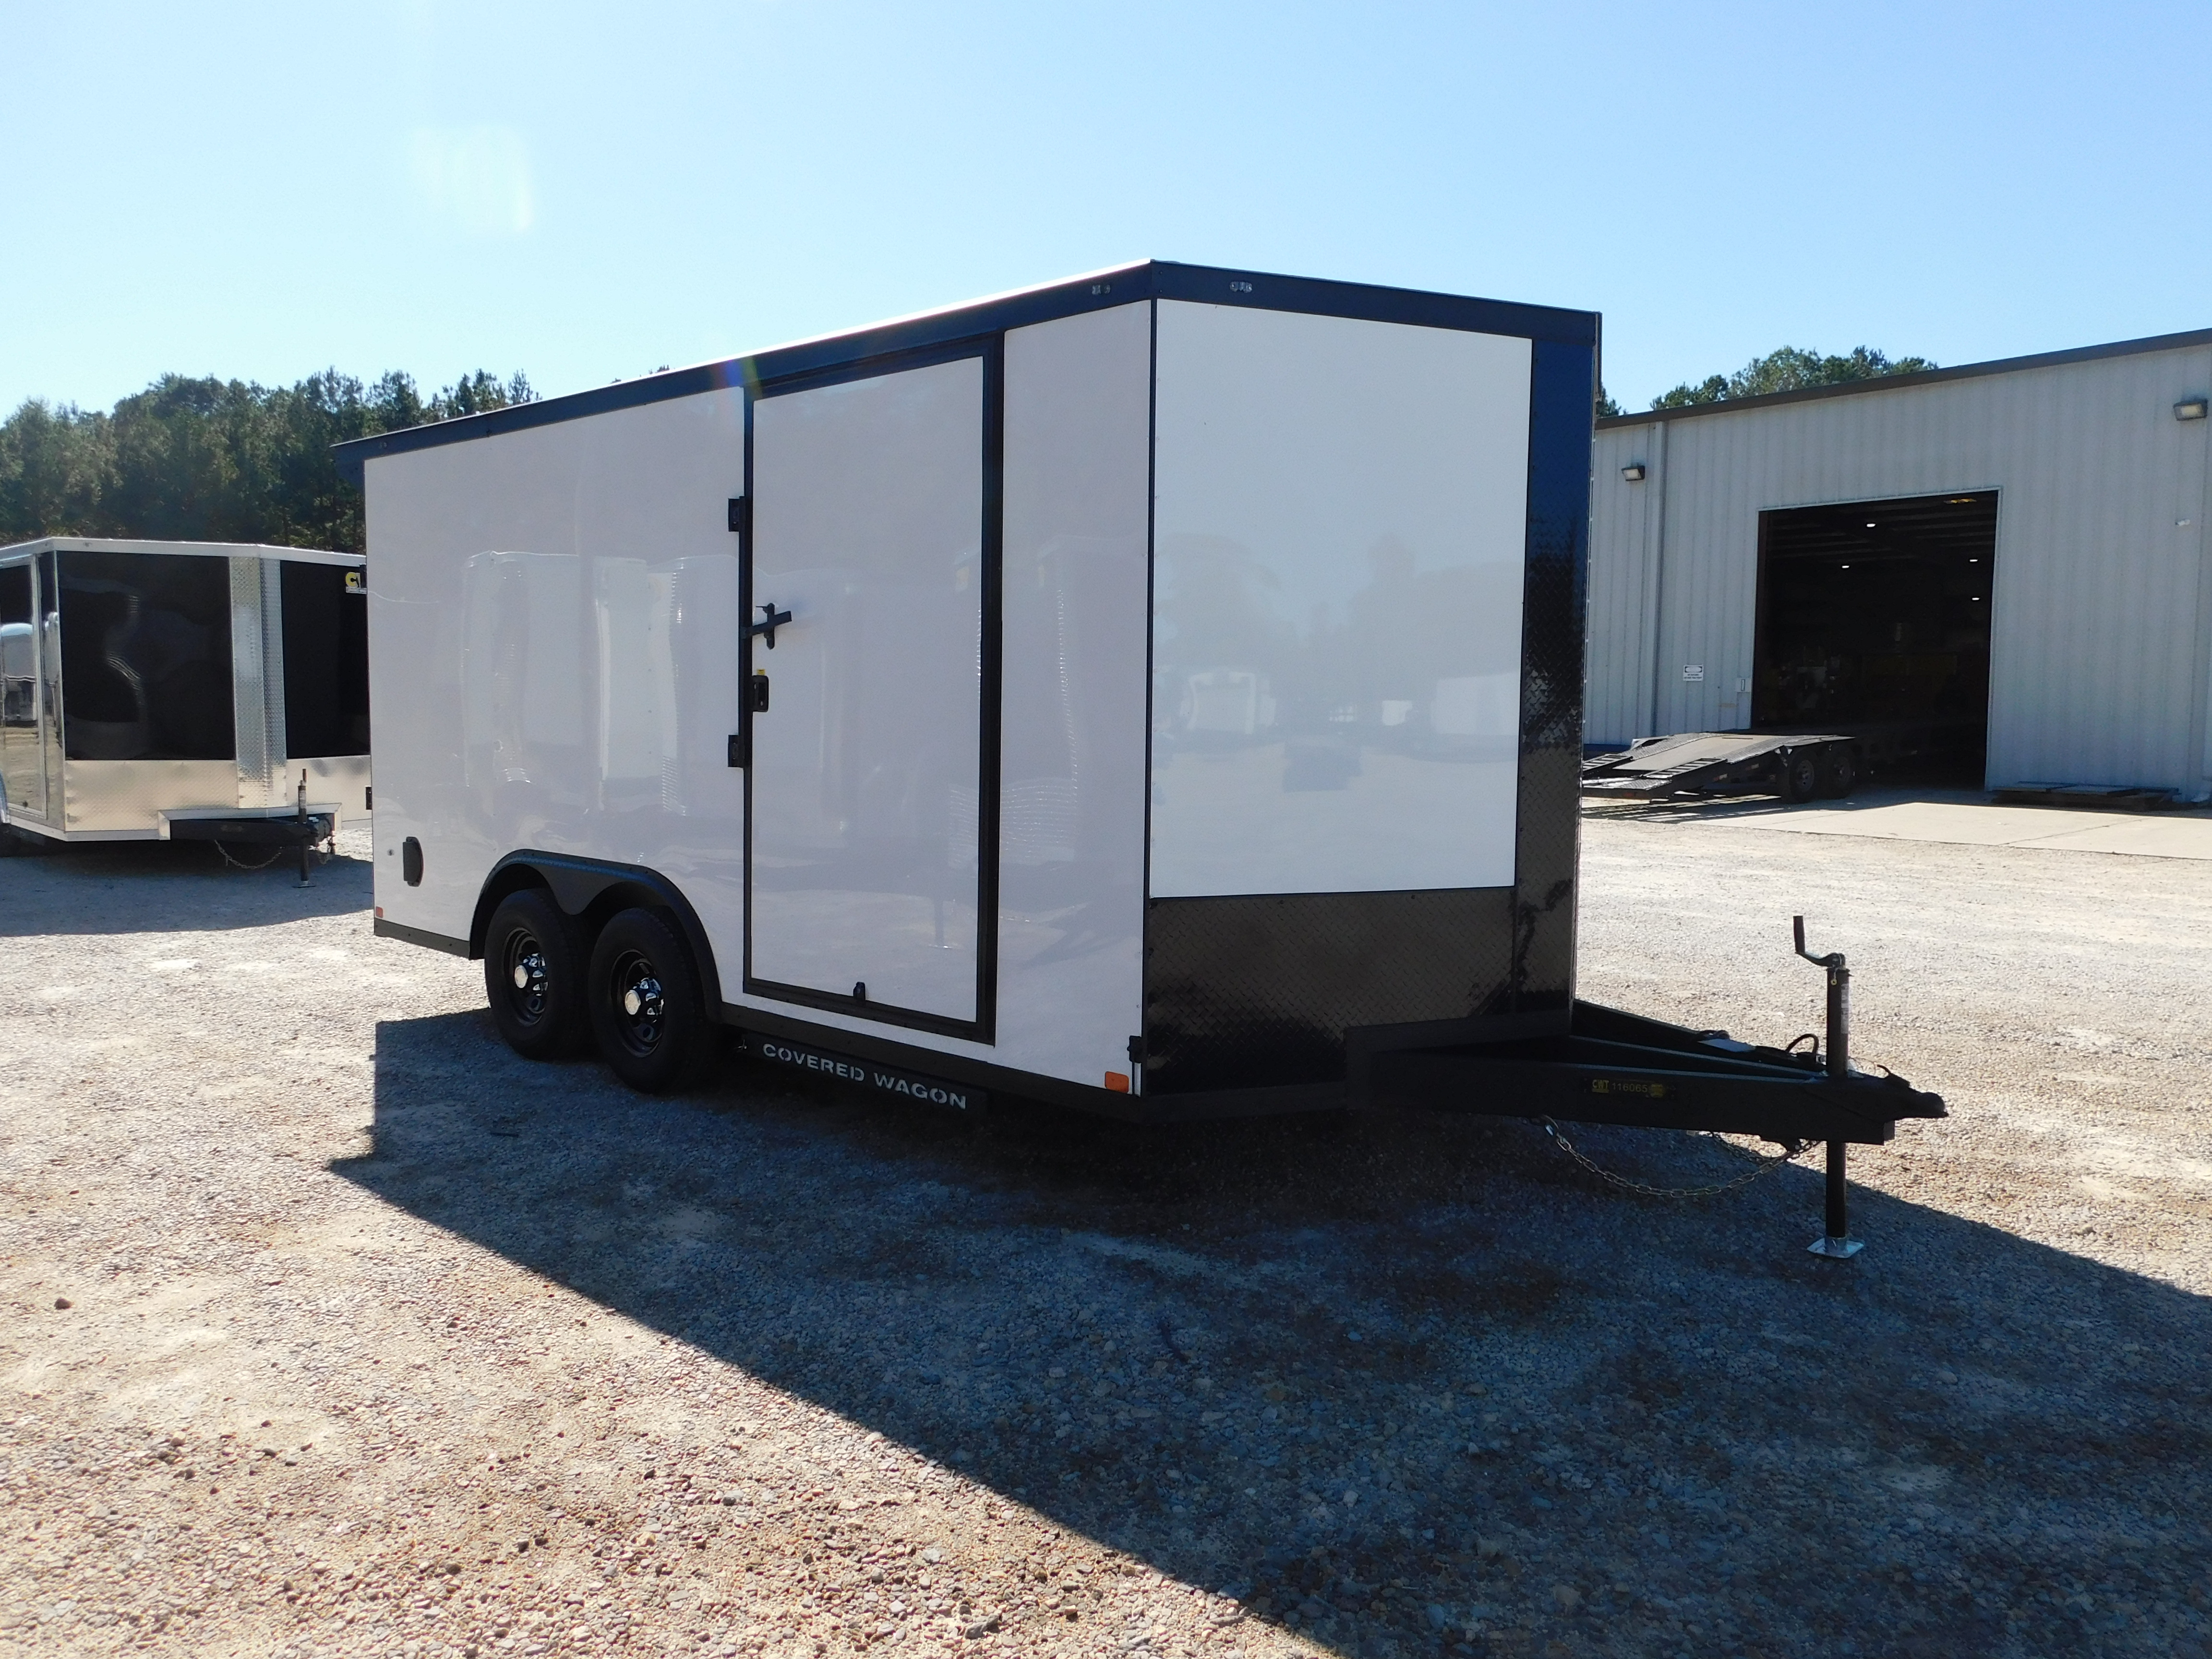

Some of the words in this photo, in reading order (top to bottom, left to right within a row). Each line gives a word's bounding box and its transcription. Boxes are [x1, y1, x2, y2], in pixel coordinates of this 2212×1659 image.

[762, 1043, 865, 1082] COVERED
[873, 1072, 966, 1110] WAGON
[1592, 1079, 1610, 1089] CWT
[1611, 1082, 1648, 1093] 116065
